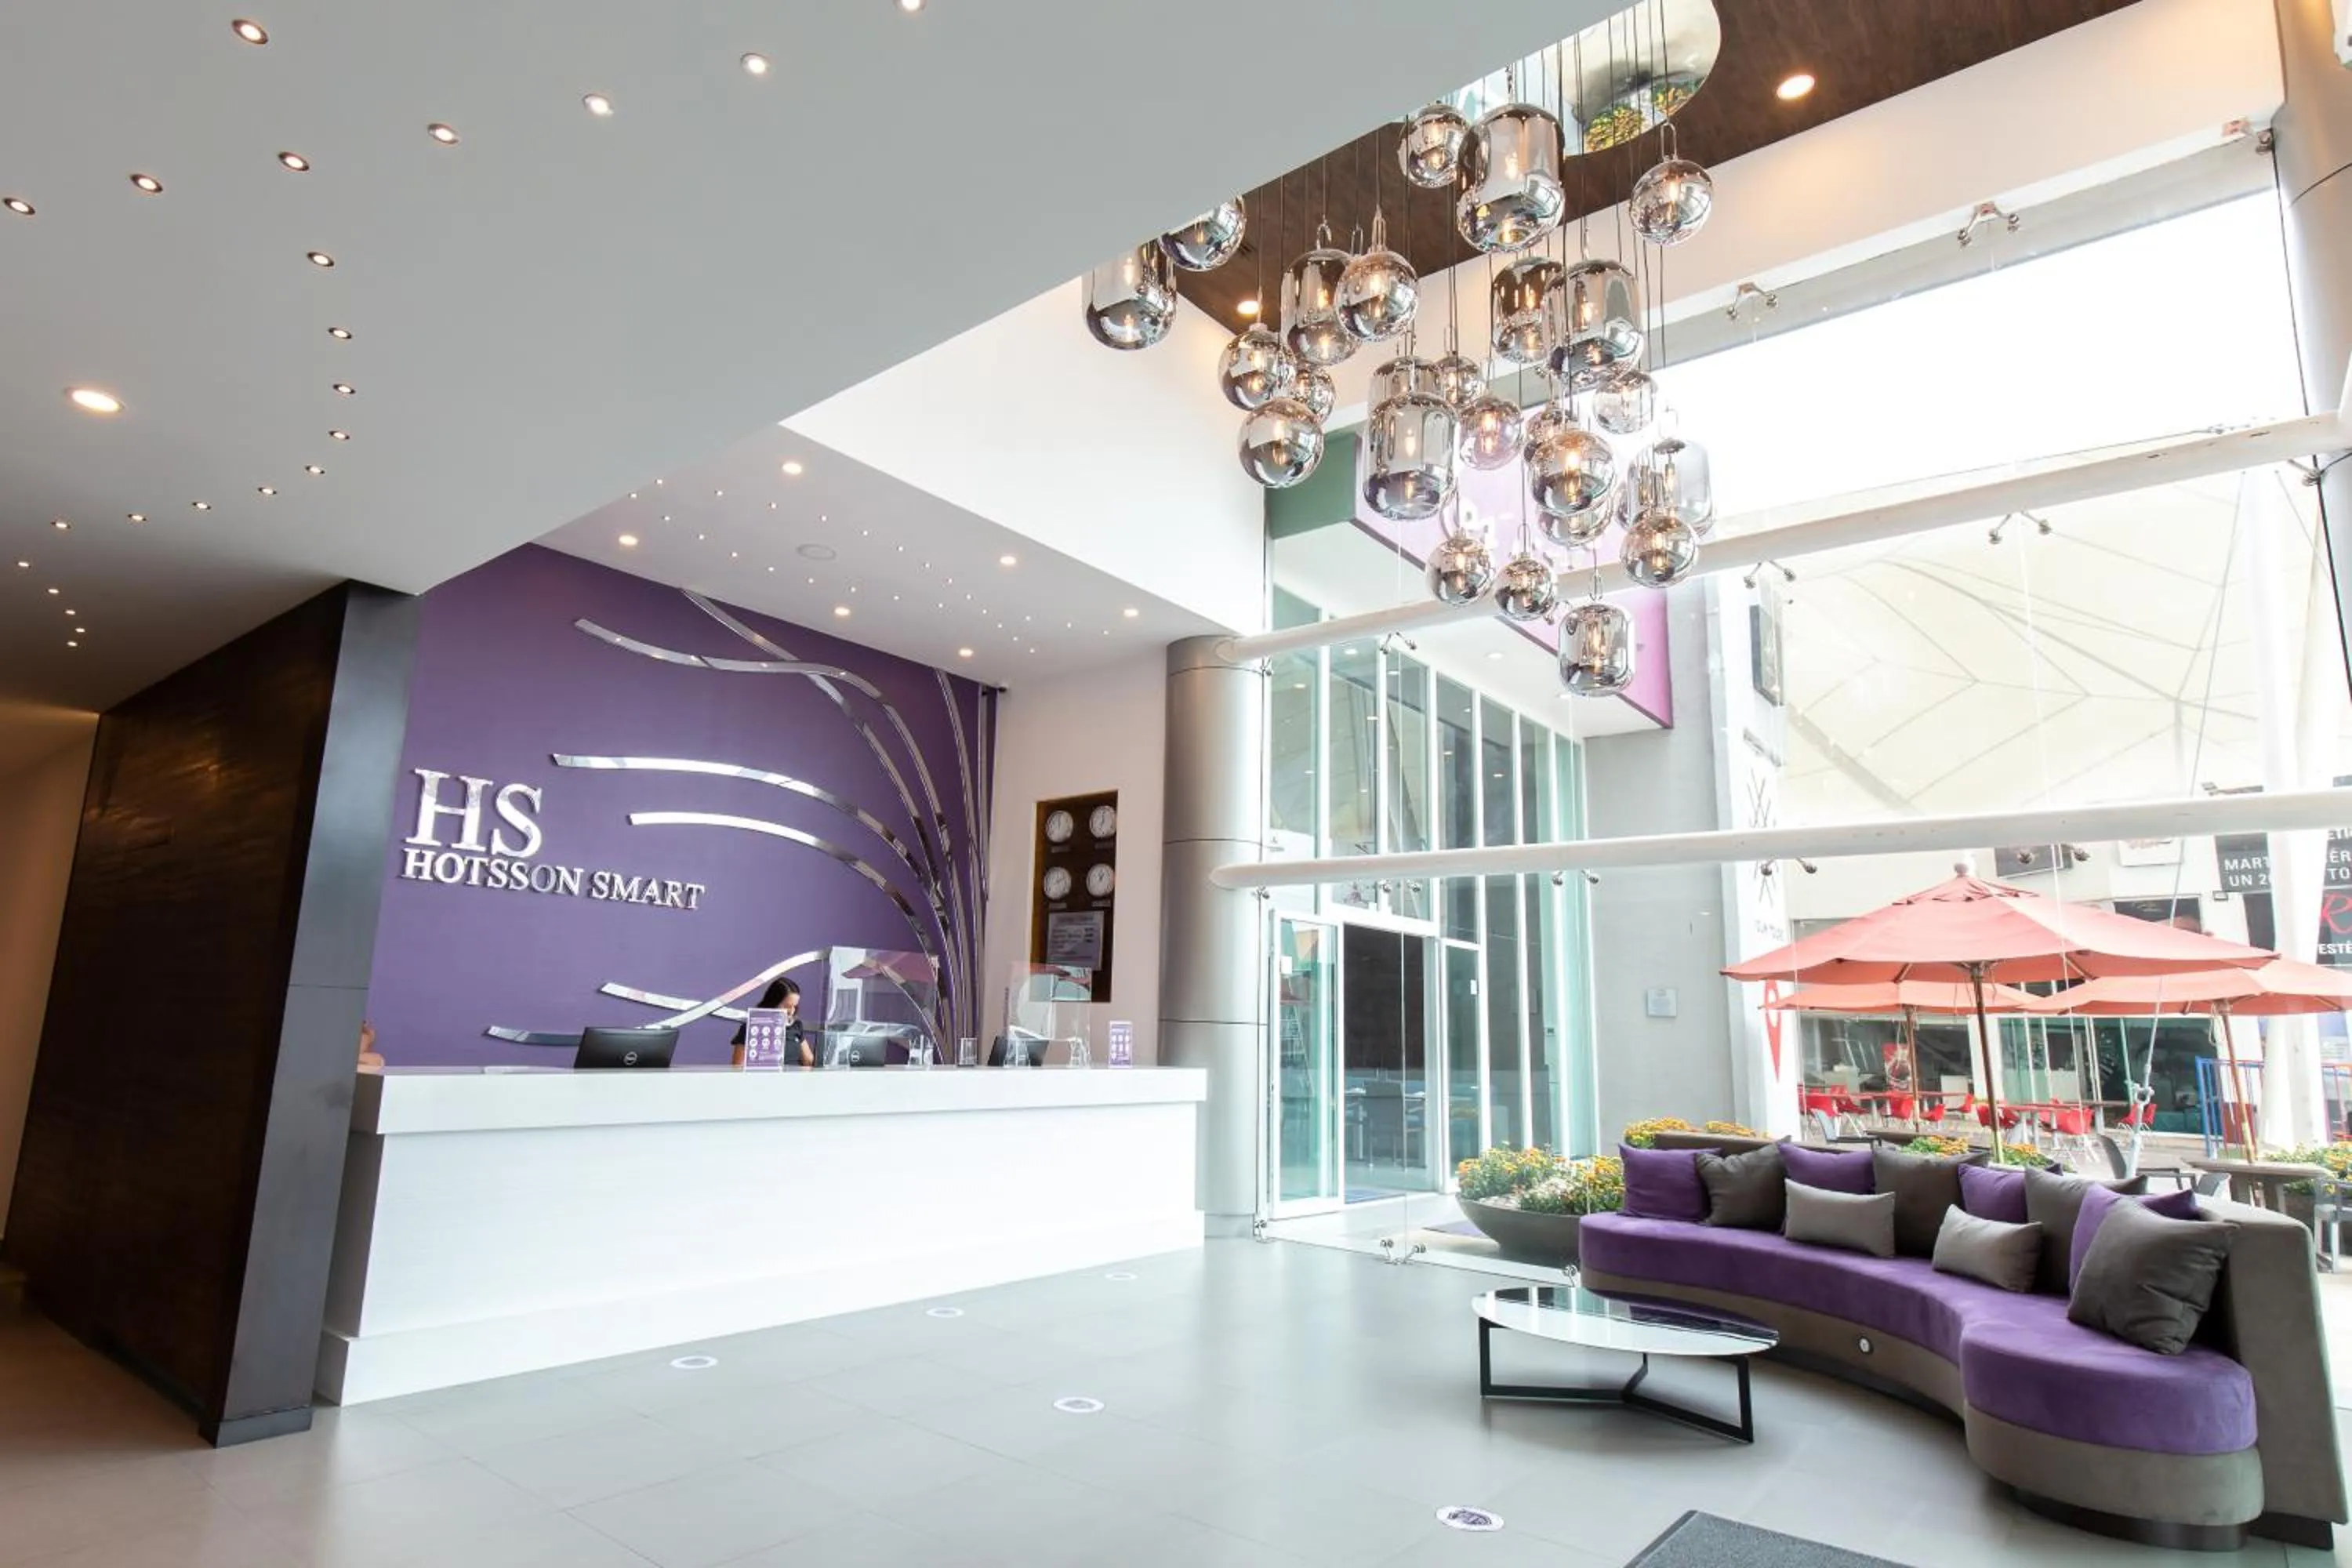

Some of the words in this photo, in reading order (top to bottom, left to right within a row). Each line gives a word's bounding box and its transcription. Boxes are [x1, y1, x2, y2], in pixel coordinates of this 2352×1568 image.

[405, 768, 543, 858] HS
[401, 848, 584, 896] HOTSSON
[591, 871, 706, 910] SMART
[2229, 874, 2252, 887] UN
[2326, 866, 2350, 880] TO
